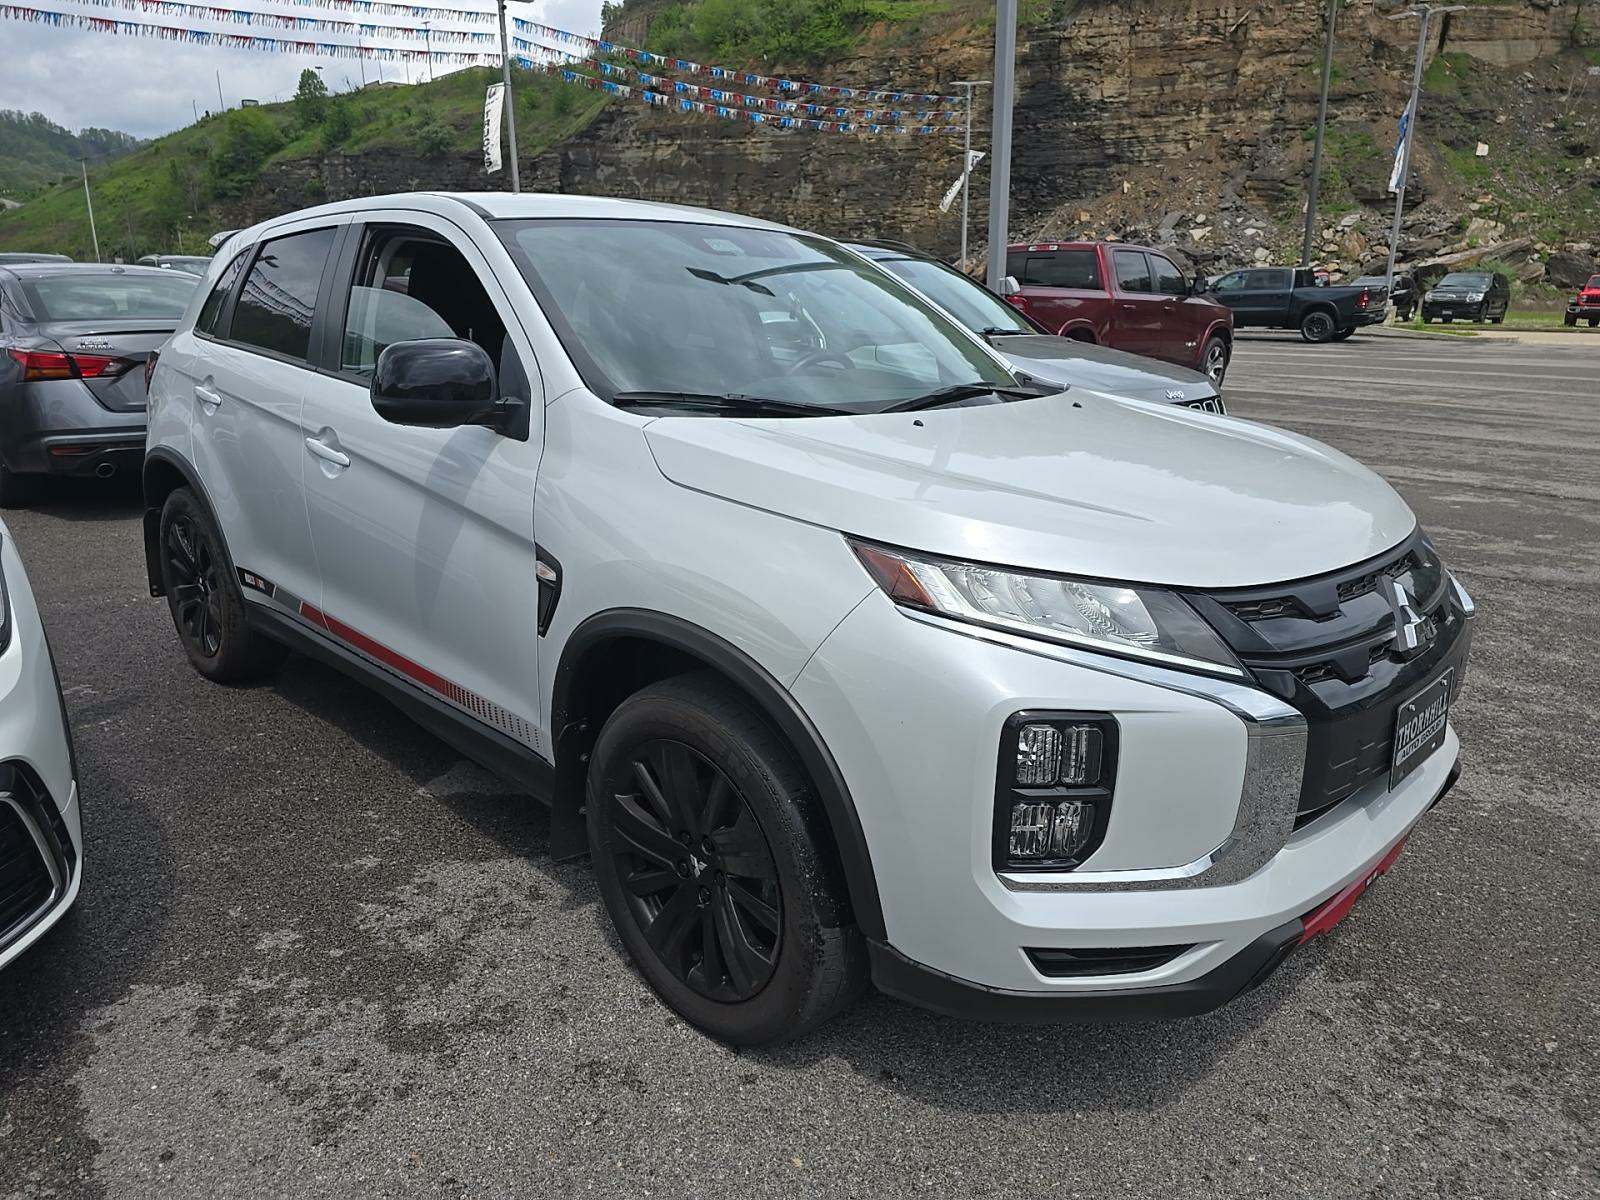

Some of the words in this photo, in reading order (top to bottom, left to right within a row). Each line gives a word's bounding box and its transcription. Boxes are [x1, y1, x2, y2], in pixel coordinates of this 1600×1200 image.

[1165, 389, 1185, 400] Jeep
[1398, 692, 1447, 750] THORNHILL
[1401, 738, 1420, 759] AUTO
